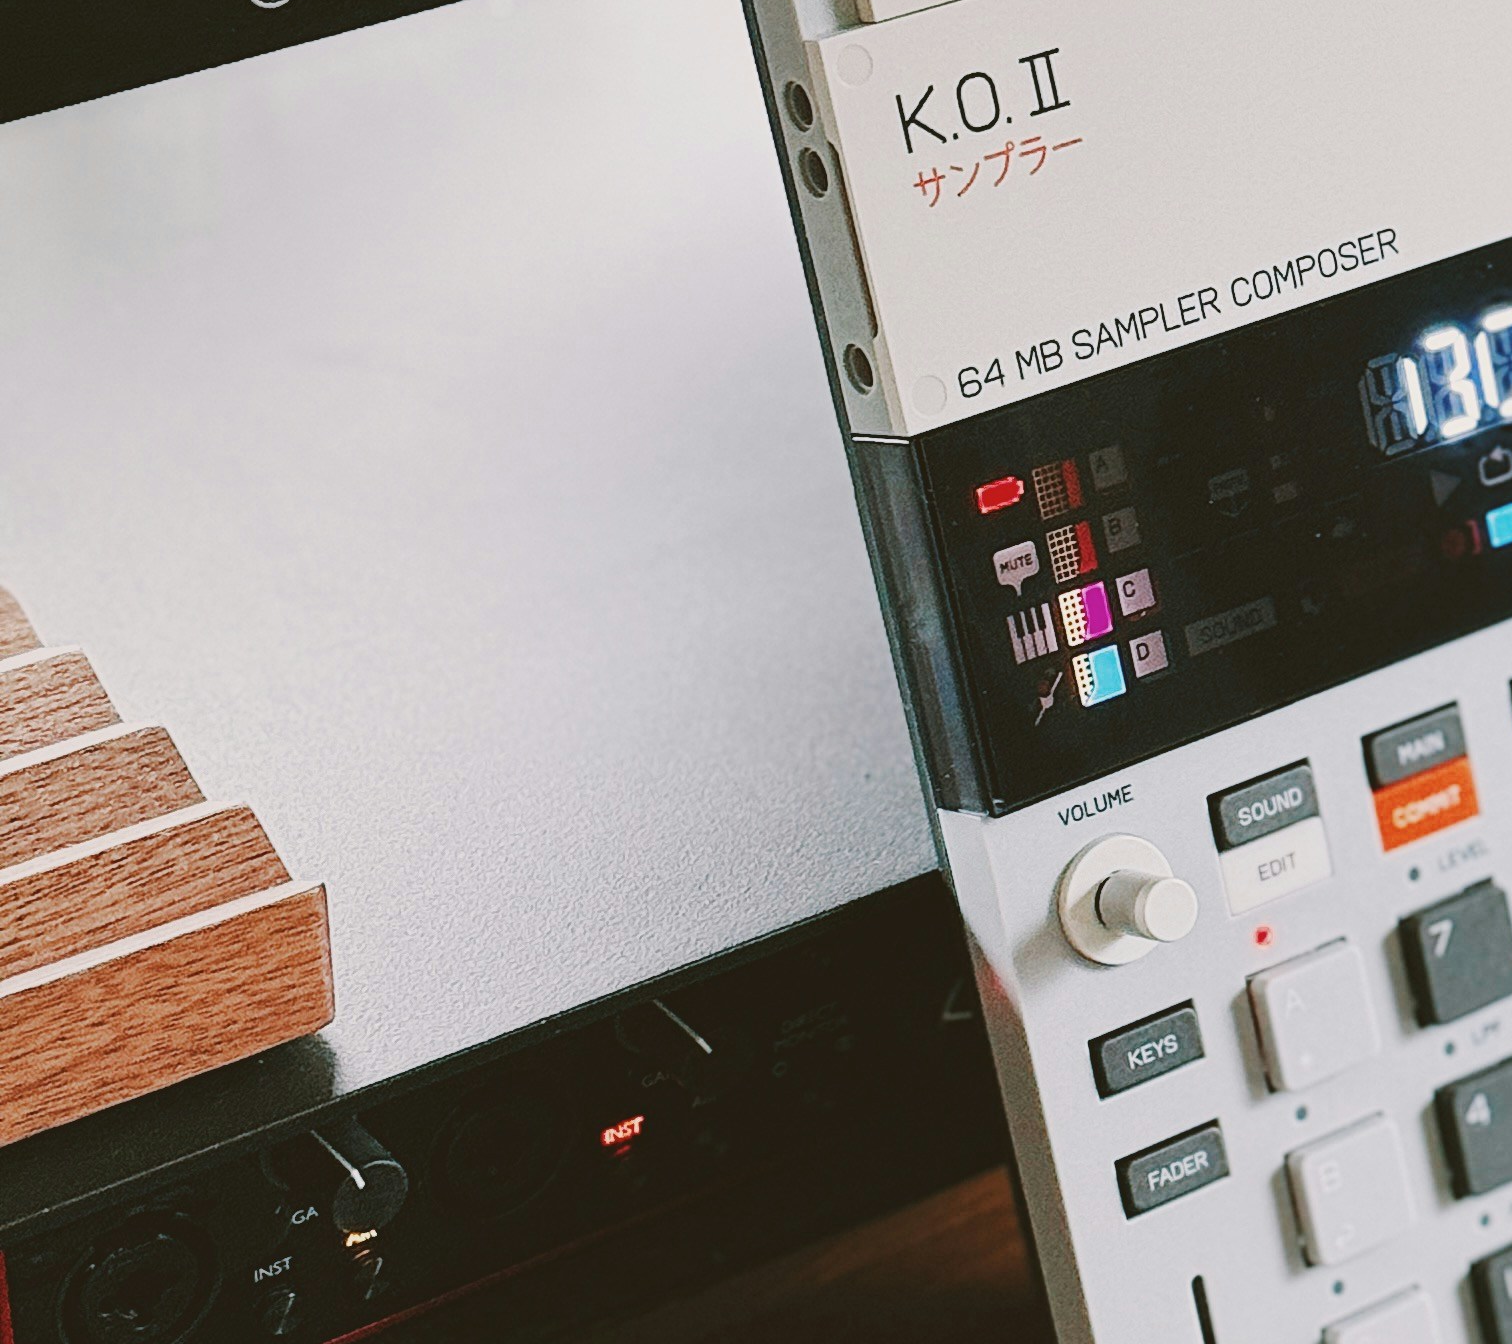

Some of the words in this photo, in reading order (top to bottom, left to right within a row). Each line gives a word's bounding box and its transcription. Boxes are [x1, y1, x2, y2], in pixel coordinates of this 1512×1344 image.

[913, 136, 1083, 208] サンプラー
[957, 358, 1005, 398] 64
[1015, 338, 1064, 380] MB
[1070, 286, 1223, 360] SAMPLER
[1230, 228, 1399, 307] COMPOSER
[999, 552, 1034, 574] MUTE
[1122, 580, 1137, 599] C
[1135, 642, 1150, 662] D
[1397, 730, 1447, 766] MAIN
[1057, 784, 1135, 826] VOLUME
[1238, 787, 1303, 827] SOUND
[1258, 852, 1297, 882] EDIT
[1428, 919, 1453, 958] 7
[1284, 989, 1304, 1017] A
[1126, 1033, 1180, 1070] KEYS
[1465, 1092, 1491, 1127] 4
[602, 1115, 645, 1145] INST
[1147, 1150, 1210, 1191] FADER
[1320, 1161, 1341, 1192] B
[254, 1256, 293, 1283] INST
